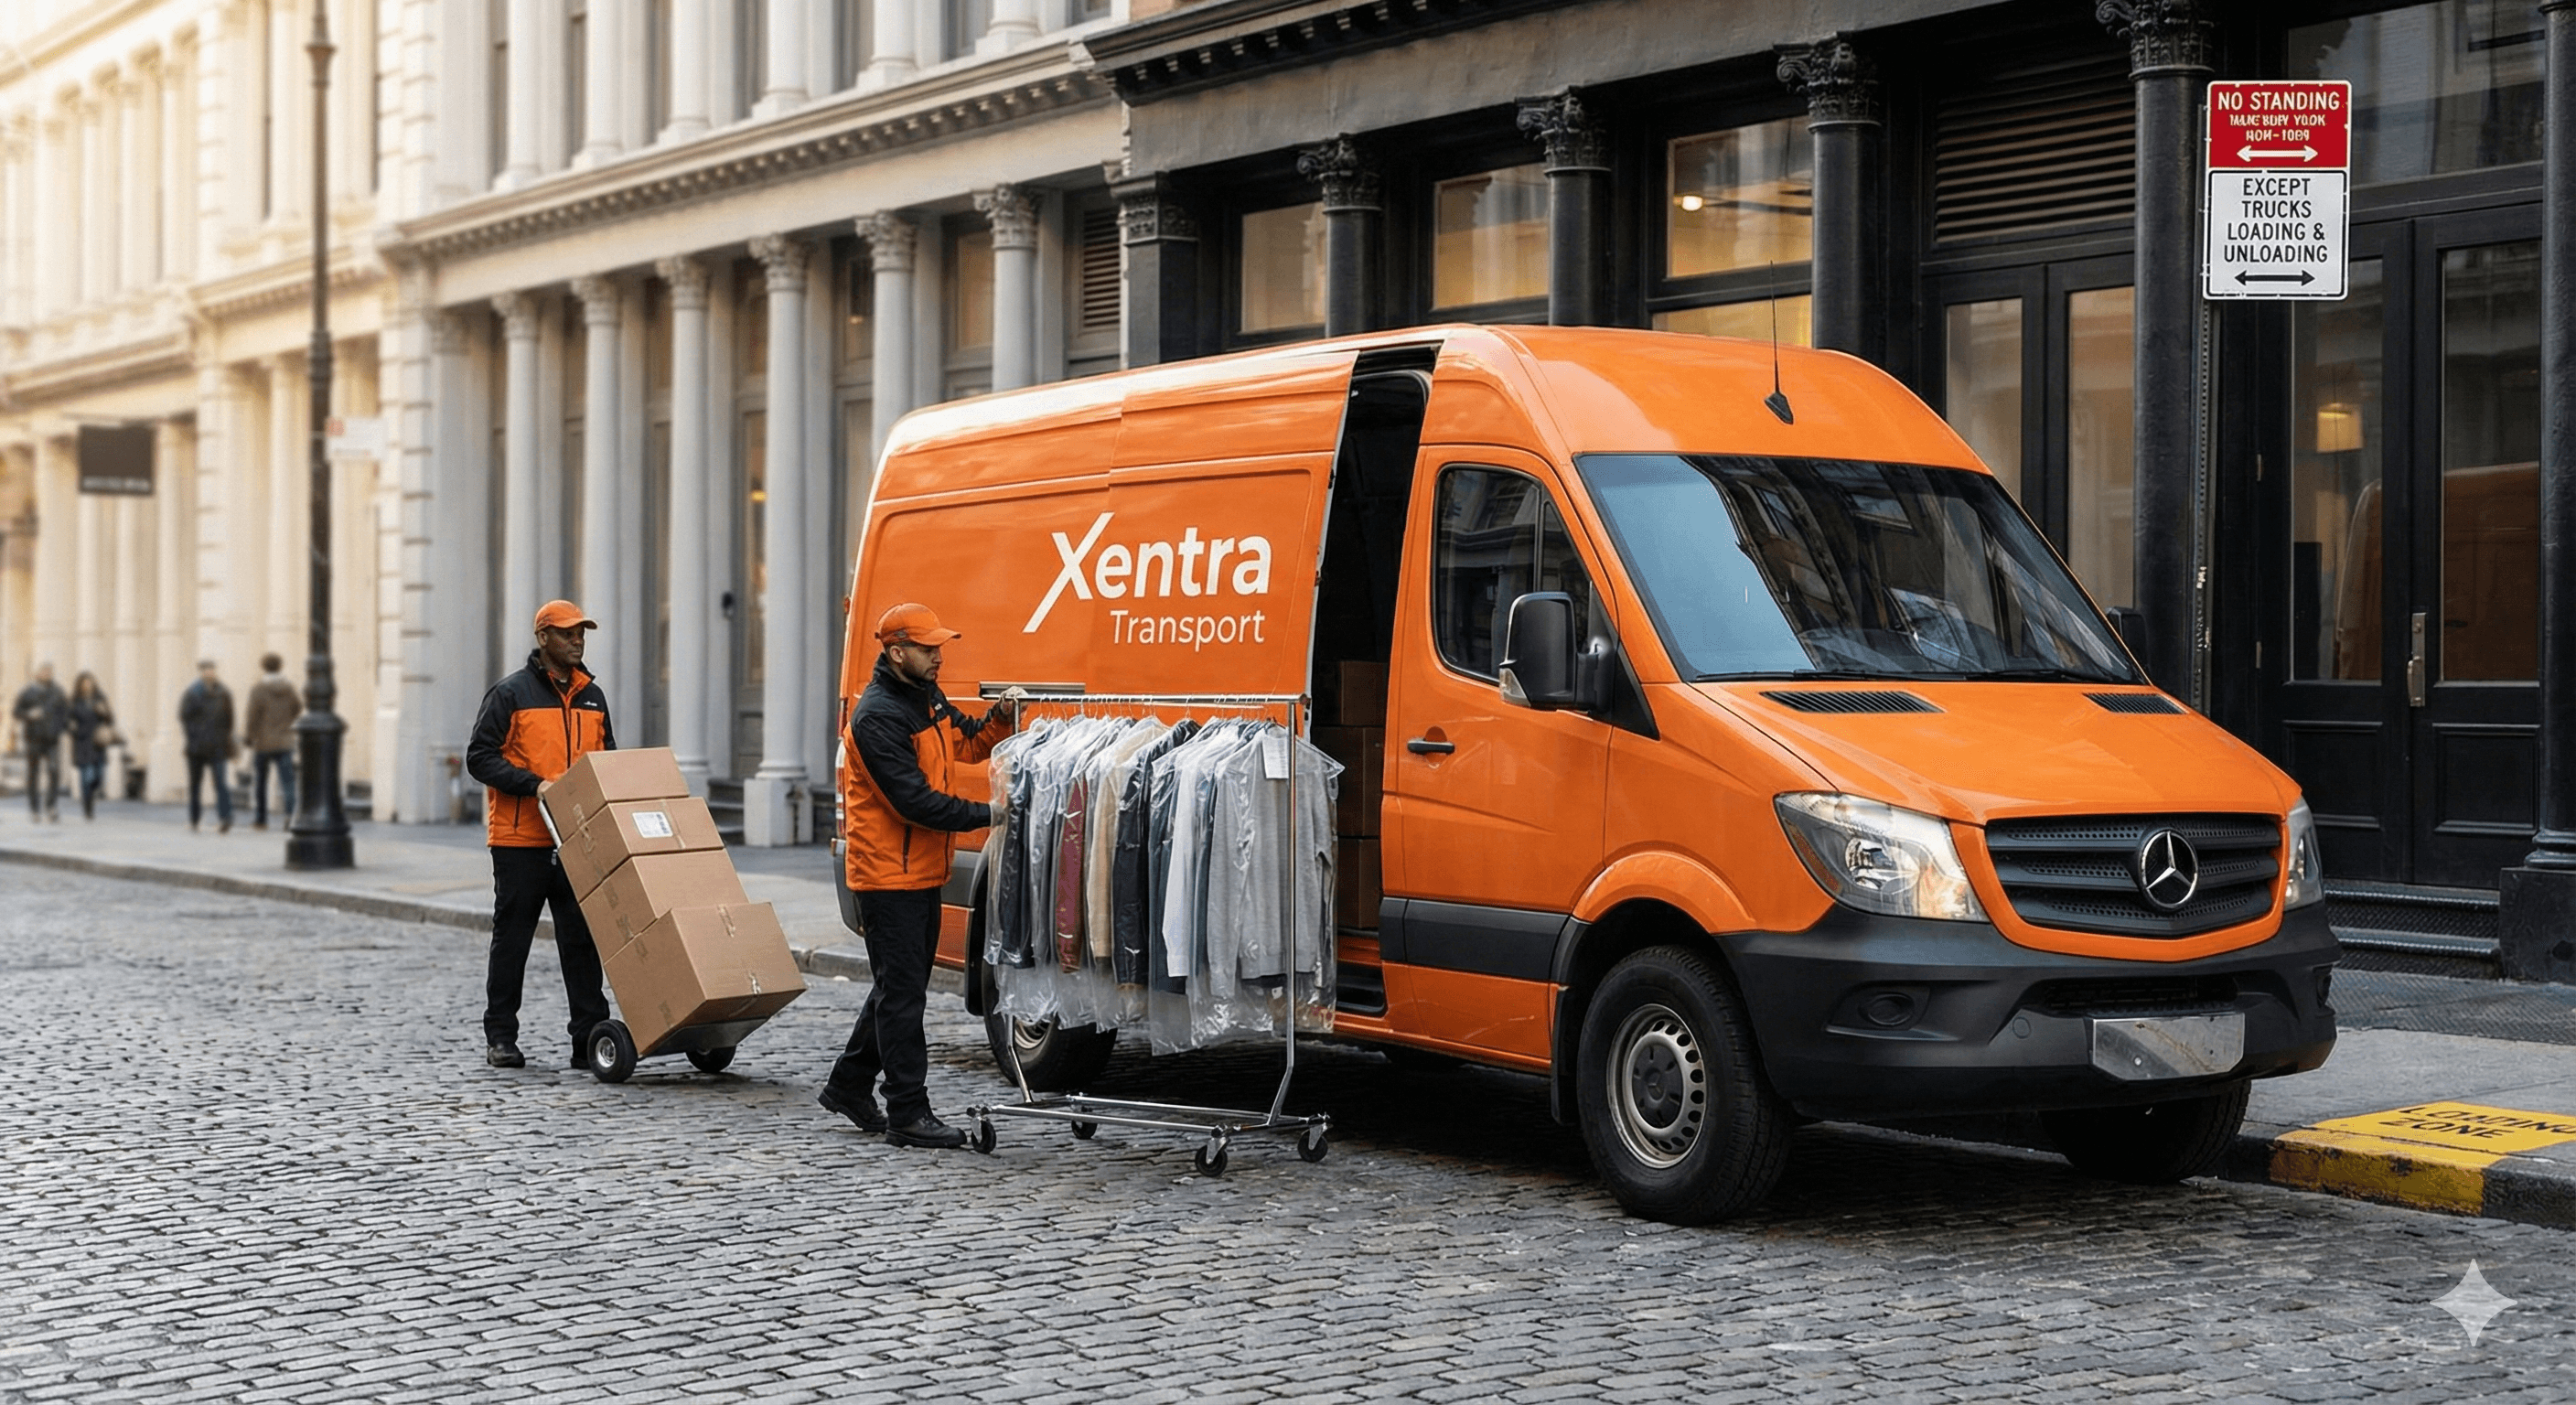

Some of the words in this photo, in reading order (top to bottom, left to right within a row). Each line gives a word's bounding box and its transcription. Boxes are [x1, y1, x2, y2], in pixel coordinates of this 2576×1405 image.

[2217, 91, 2243, 111] NO
[2249, 91, 2340, 111] STANDING
[2243, 178, 2311, 196] EXCEPT
[2241, 200, 2312, 219] TRUCKS
[2227, 223, 2306, 241] LOADING
[2313, 223, 2325, 241] &
[2224, 245, 2328, 263] UNLOADING
[1022, 511, 1272, 633] Xentra
[1110, 609, 1265, 652] Transport
